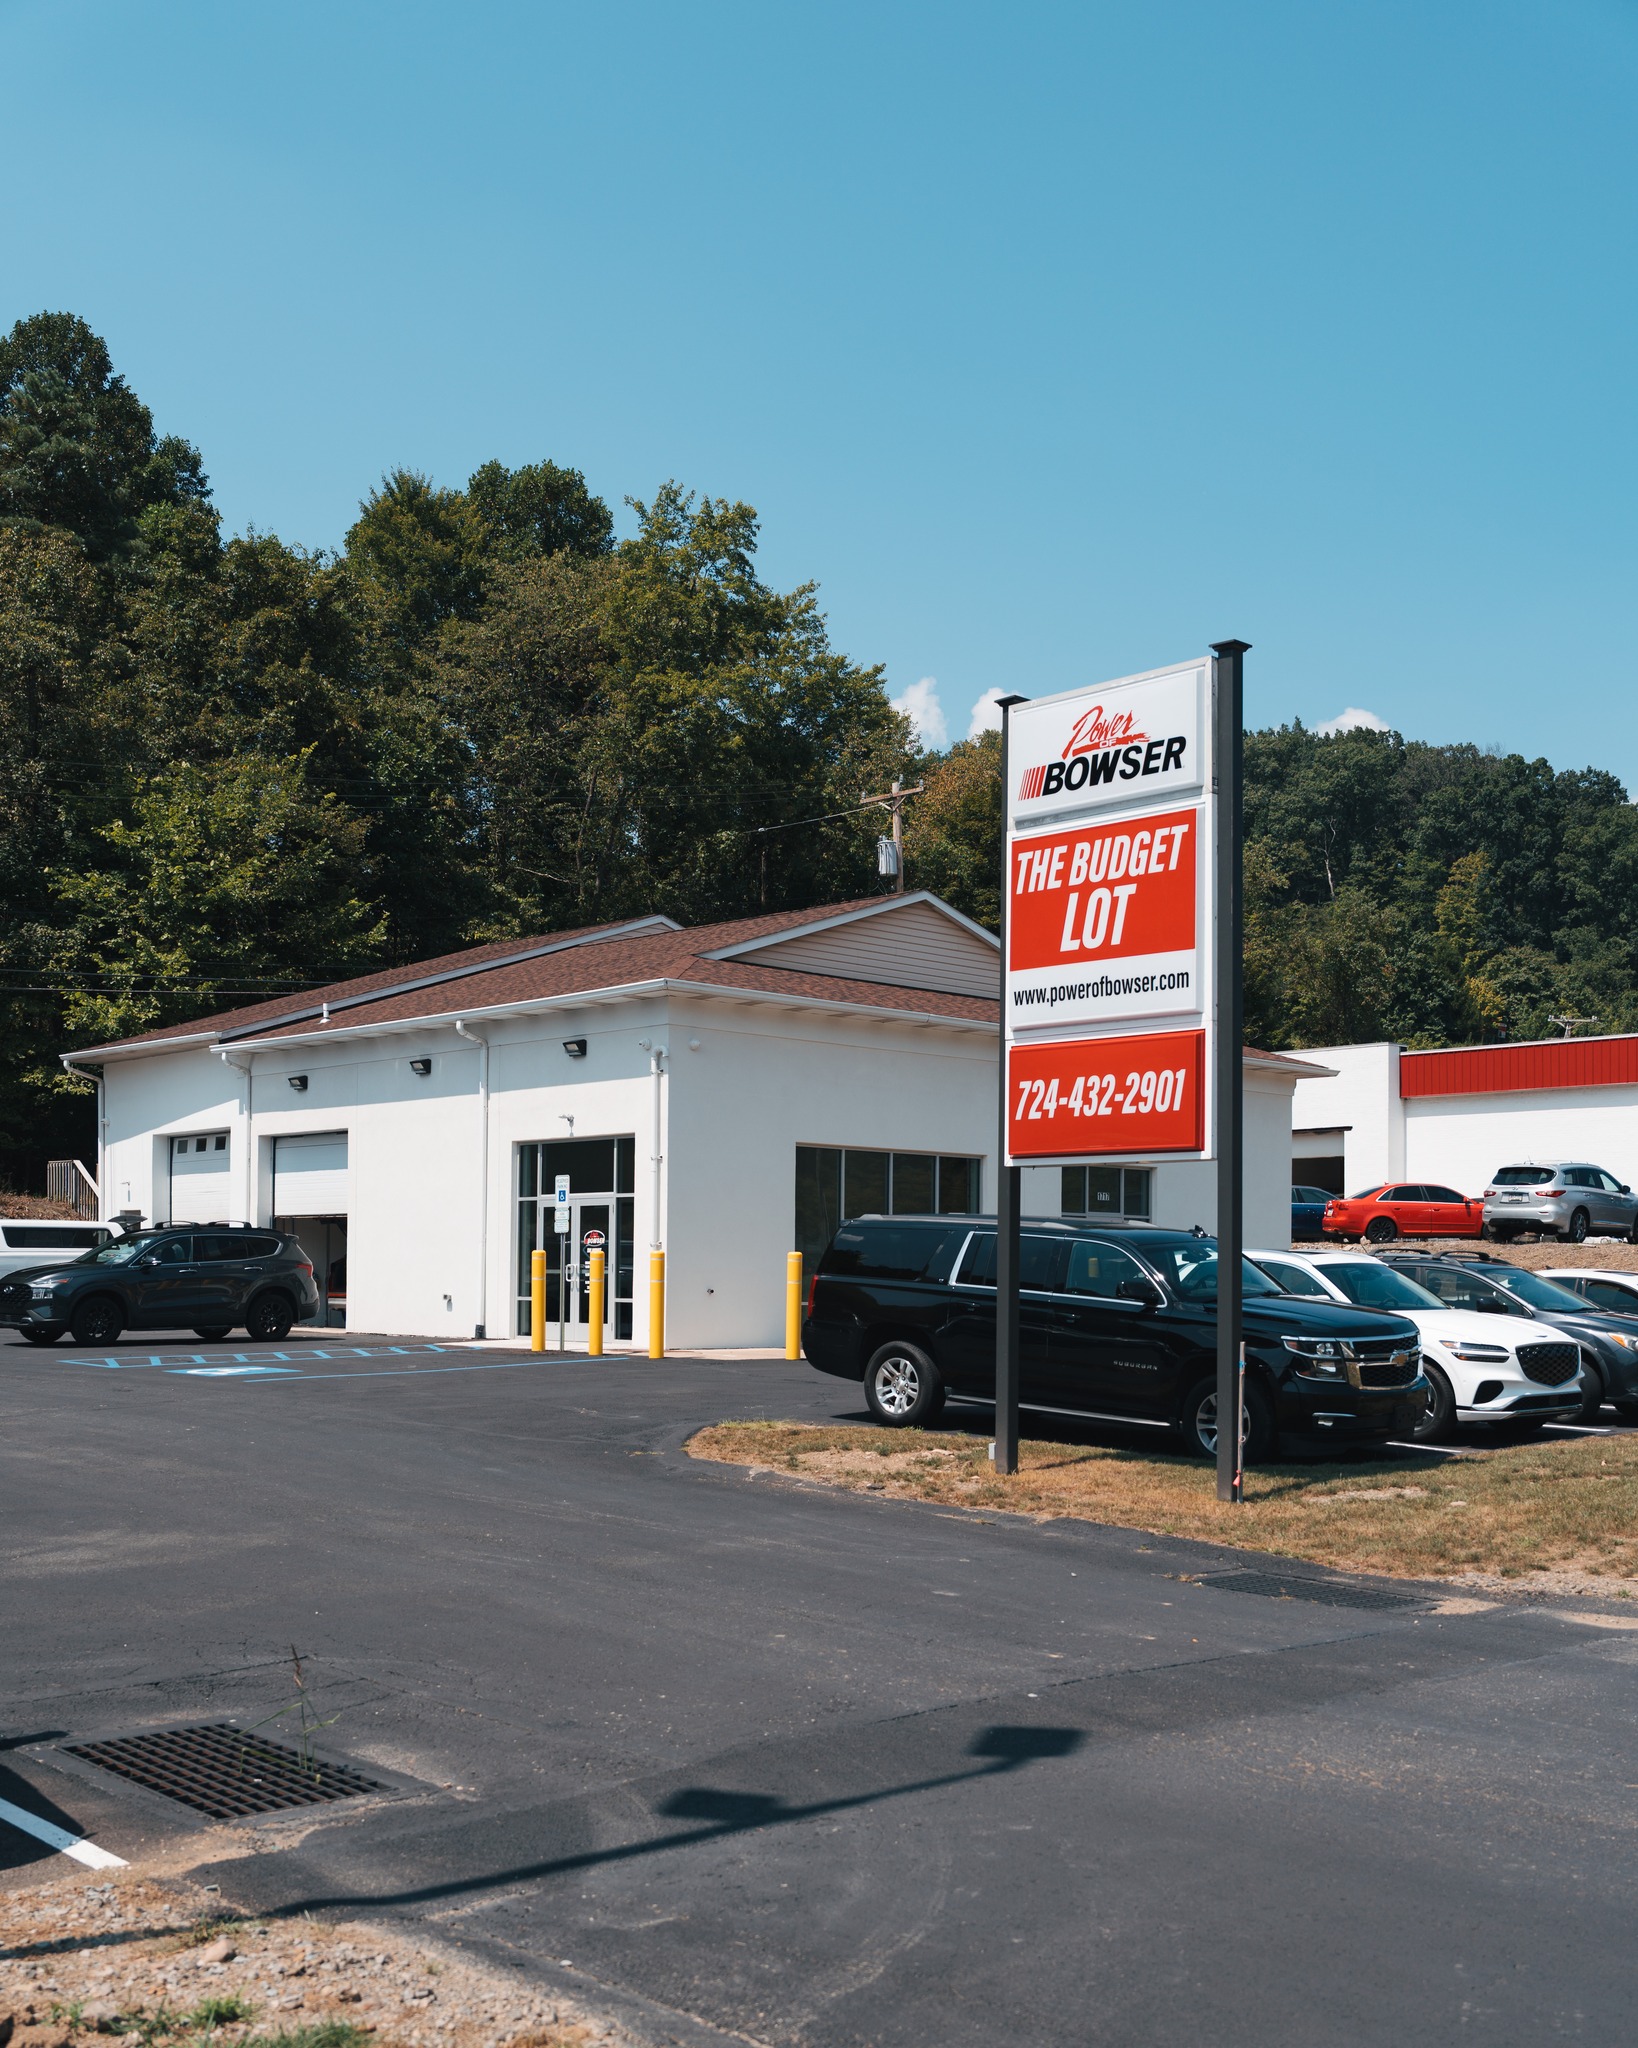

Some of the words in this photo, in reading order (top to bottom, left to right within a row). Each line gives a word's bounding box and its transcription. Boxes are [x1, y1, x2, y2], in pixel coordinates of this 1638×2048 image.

[1061, 705, 1141, 760] Power
[1099, 737, 1117, 749] OF
[1041, 735, 1187, 797] BOWSER
[1015, 845, 1068, 895] THE
[1068, 823, 1189, 887] BUDGET
[1060, 883, 1138, 953] LOT
[1013, 970, 1190, 1008] www.powerofbowser.com
[1014, 1068, 1187, 1121] 724-432-2901
